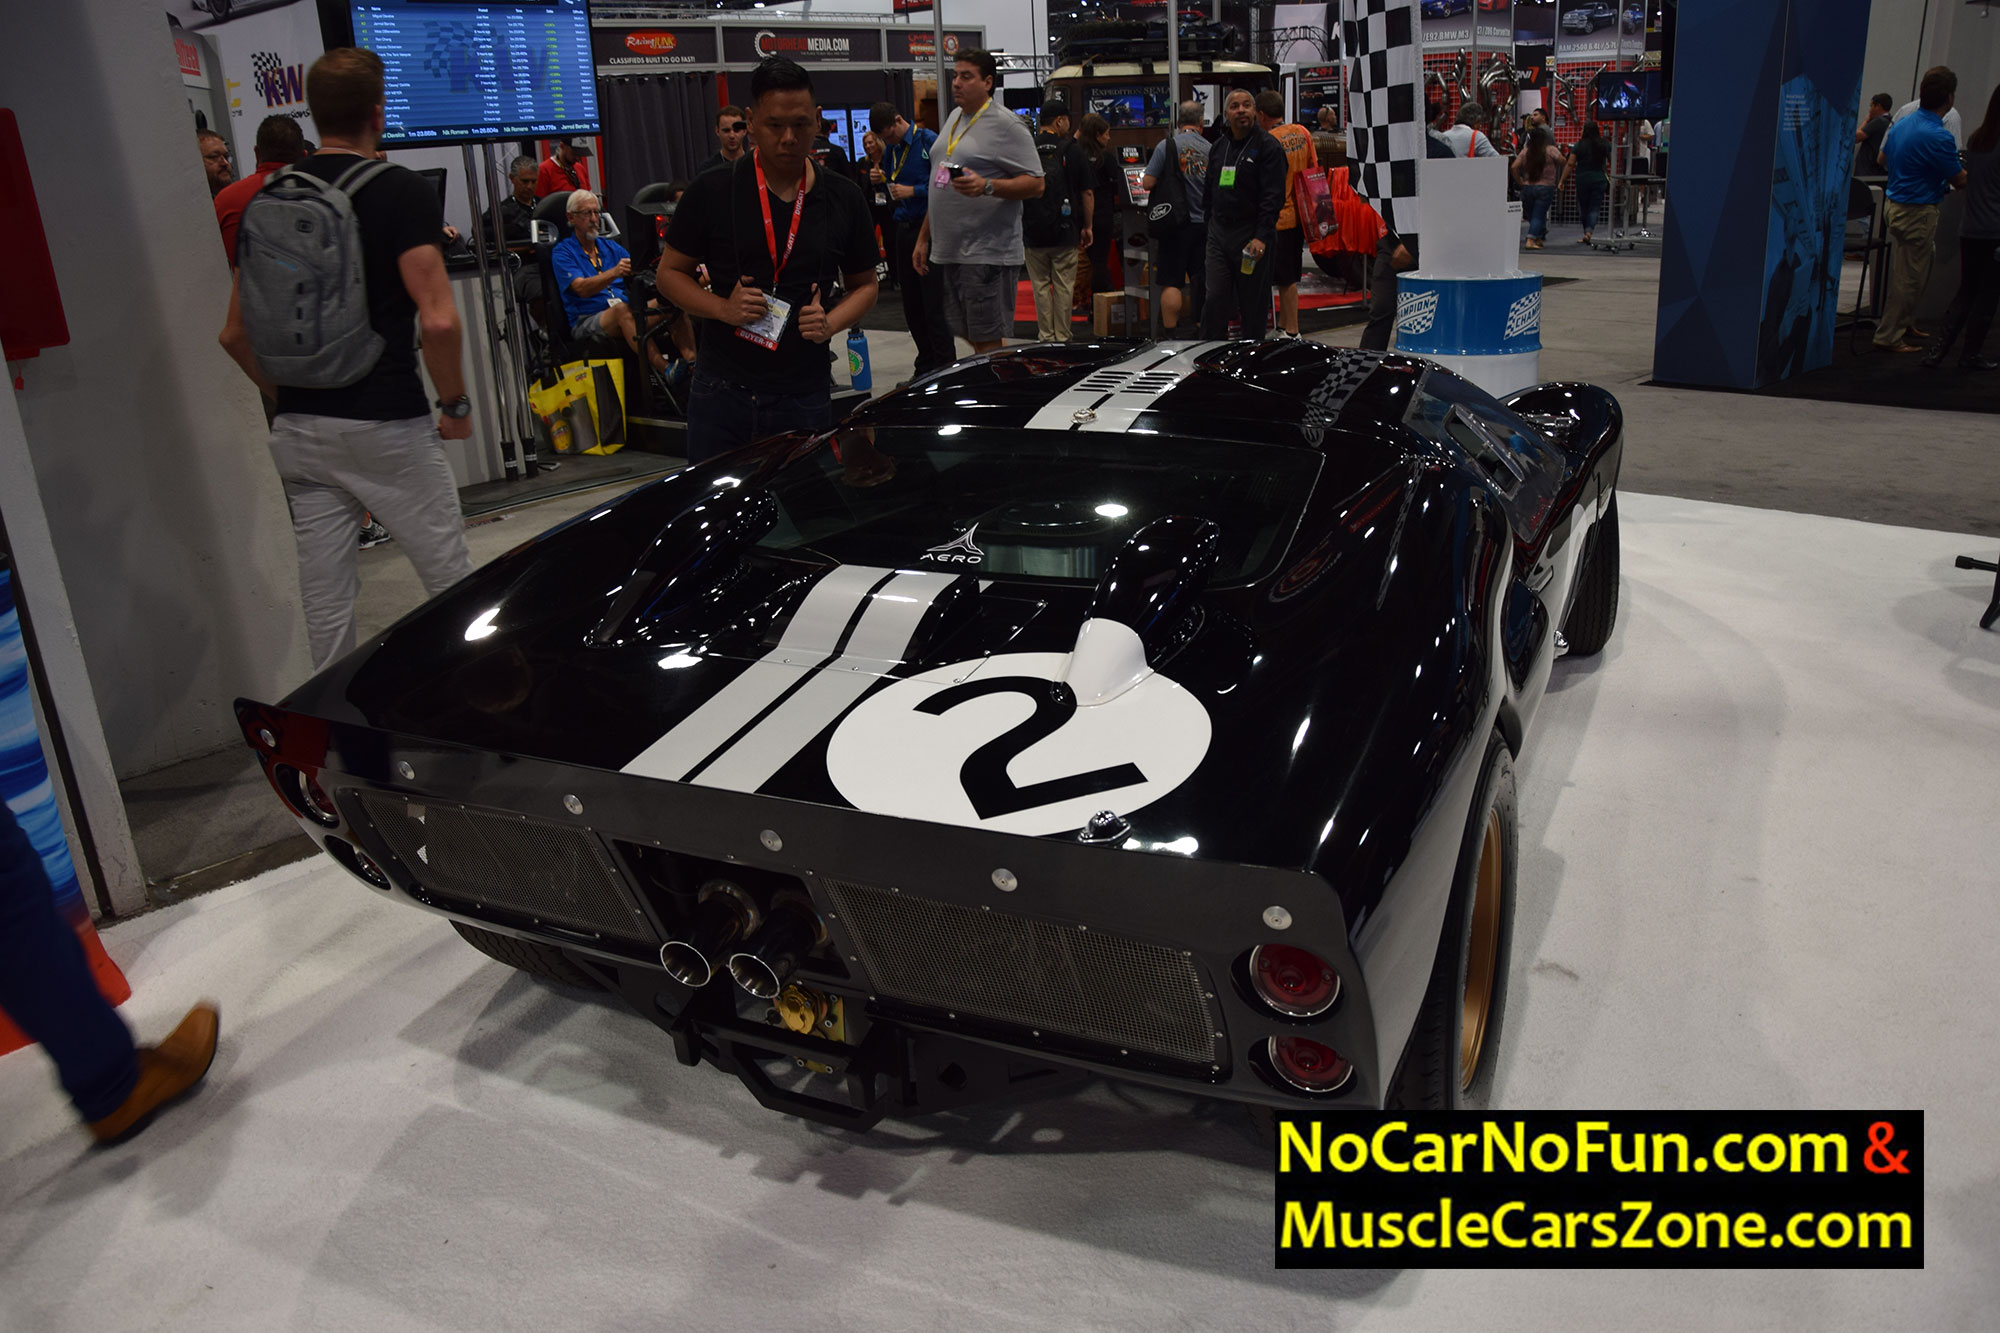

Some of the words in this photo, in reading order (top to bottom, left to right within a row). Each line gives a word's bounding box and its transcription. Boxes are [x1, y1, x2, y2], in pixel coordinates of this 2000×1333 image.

[609, 57, 645, 65] CLASSIFIEDS
[262, 64, 305, 109] KW
[794, 189, 805, 215] DUCATI
[783, 233, 796, 259] DUCATI
[739, 330, 773, 349] BUYER-16
[920, 553, 983, 565] AERO
[912, 675, 1148, 820] 2
